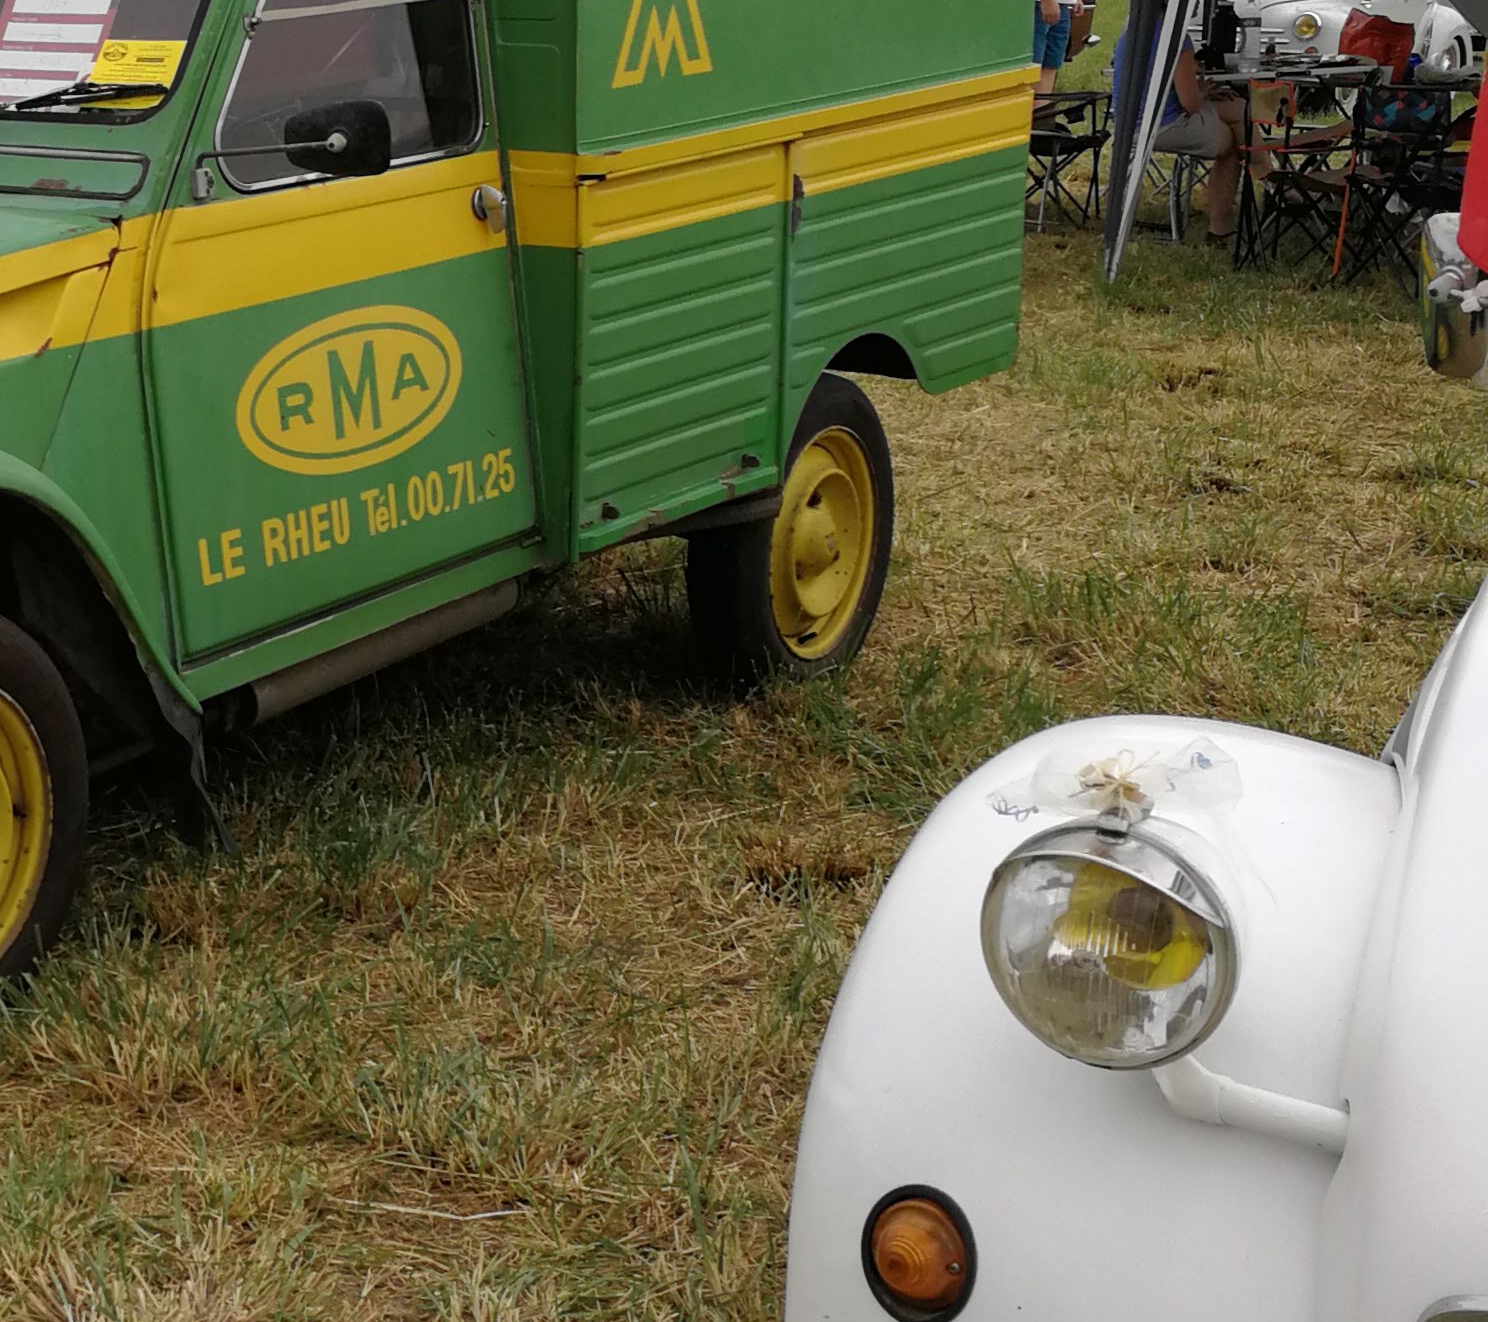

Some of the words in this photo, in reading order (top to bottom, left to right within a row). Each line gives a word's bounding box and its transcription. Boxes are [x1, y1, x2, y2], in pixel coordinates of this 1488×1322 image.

[276, 340, 430, 441] RMA
[198, 528, 246, 587] LE
[262, 497, 350, 568] RHEU
